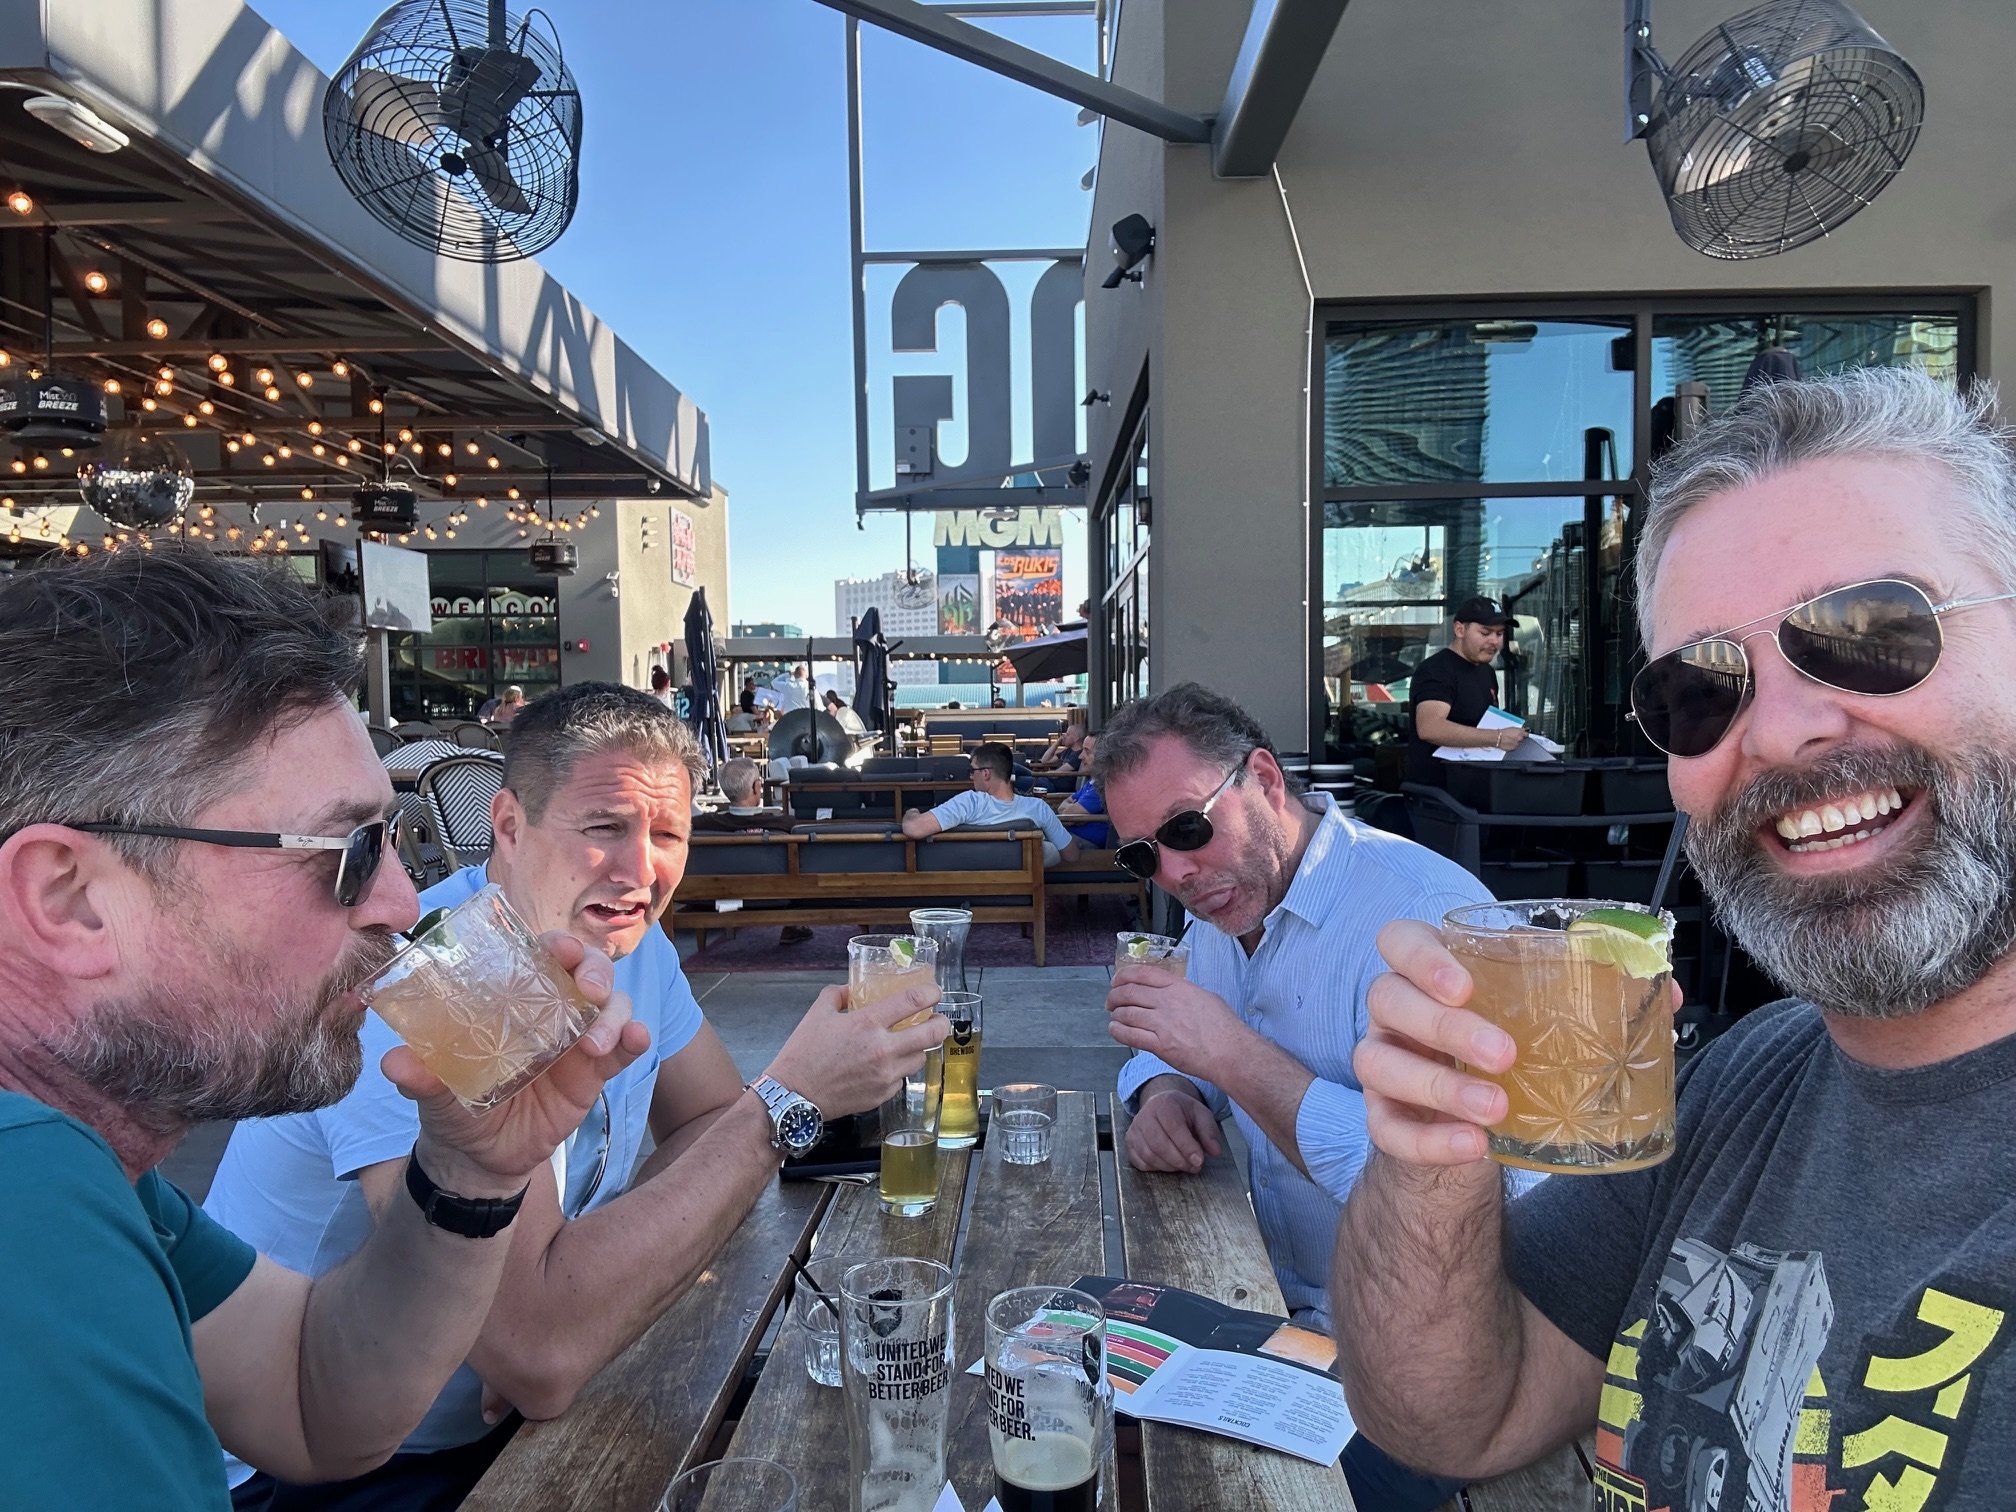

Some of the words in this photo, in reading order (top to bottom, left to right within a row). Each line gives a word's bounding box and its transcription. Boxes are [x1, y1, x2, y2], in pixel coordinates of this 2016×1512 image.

[38, 401, 79, 411] BREEZE
[934, 508, 1063, 548] MGM
[876, 1340, 926, 1361] UNITED
[929, 1332, 946, 1354] WE
[876, 1362, 922, 1381] STAND
[925, 1352, 946, 1377] FOR
[868, 1382, 920, 1401] BETTER
[1004, 1374, 1025, 1398] WE
[1001, 1394, 1025, 1419] FOR
[1000, 1413, 1036, 1441] BEER.
[1216, 1414, 1251, 1428] COCKTAILS
